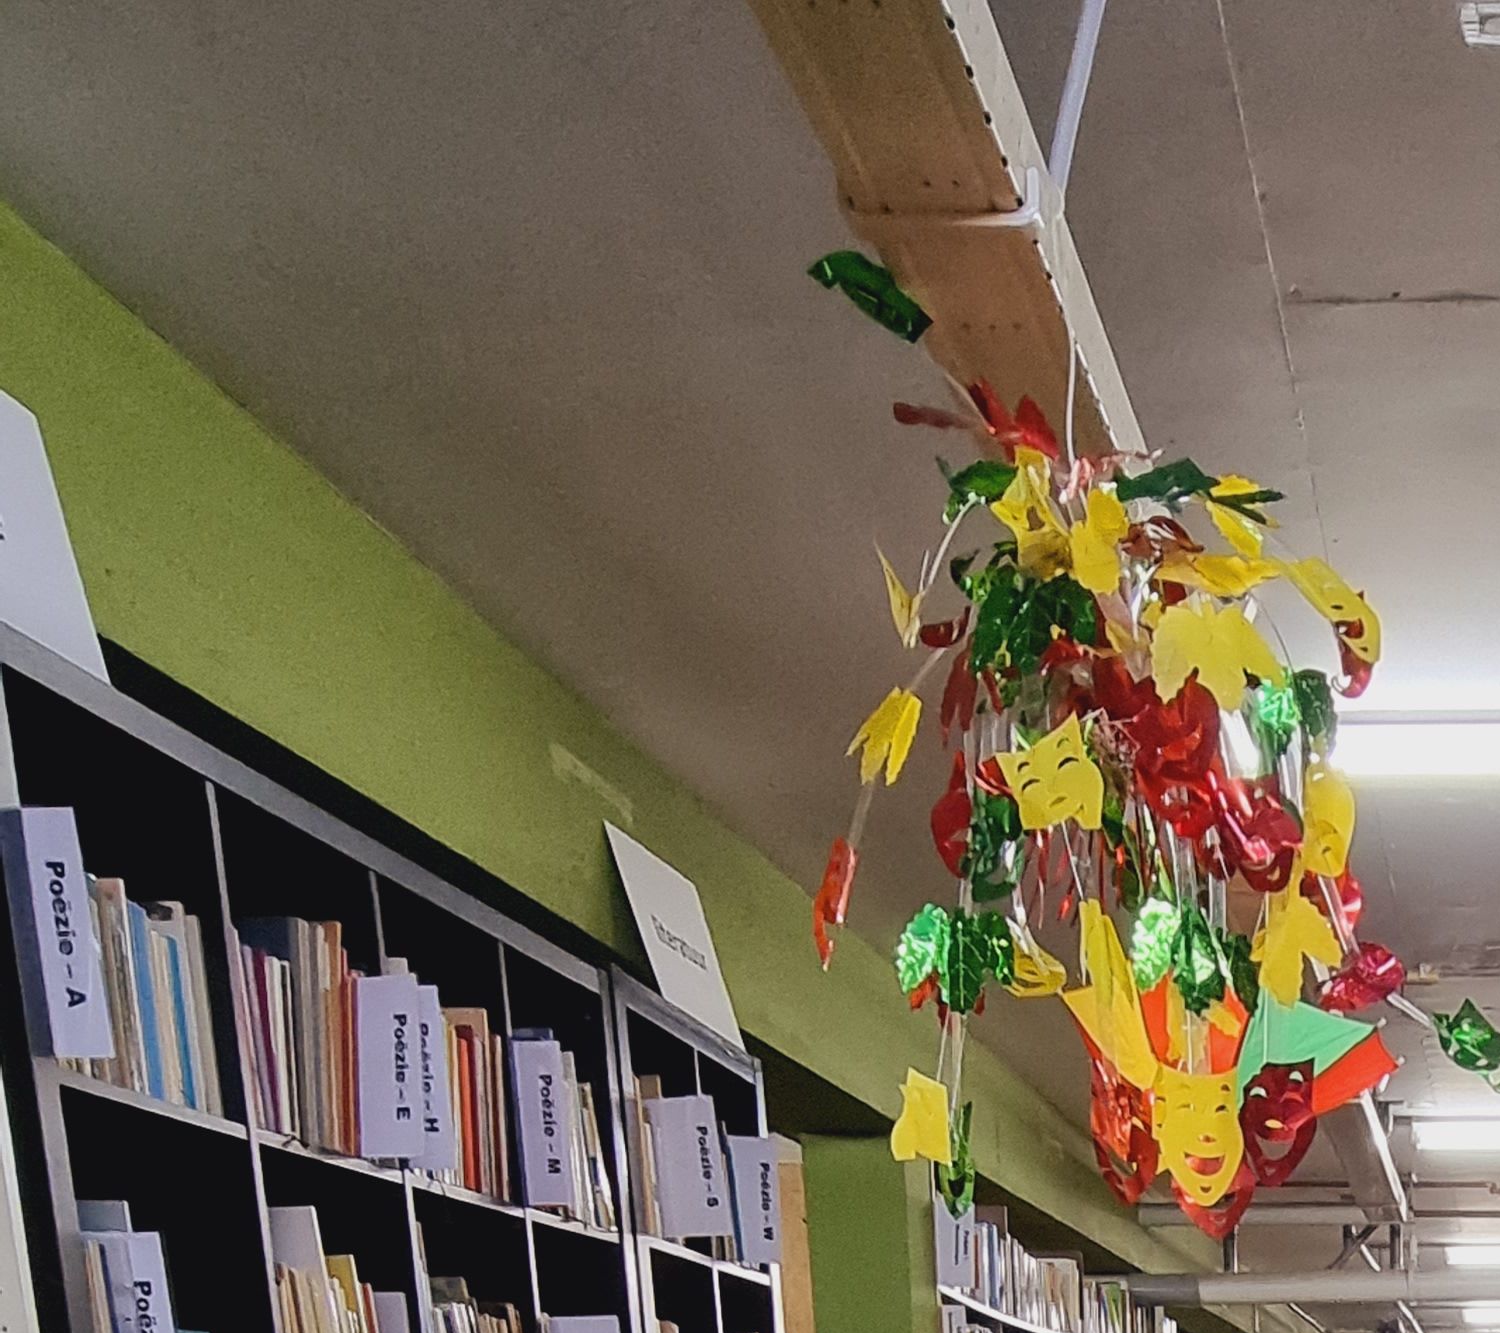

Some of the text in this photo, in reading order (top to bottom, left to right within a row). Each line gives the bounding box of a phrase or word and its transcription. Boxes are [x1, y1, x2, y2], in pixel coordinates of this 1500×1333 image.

[45, 861, 74, 955] Poëzie
[66, 987, 86, 1007] A
[393, 1014, 408, 1083] Poëzie
[397, 1107, 411, 1121] E
[424, 1118, 440, 1133] H
[539, 1074, 555, 1137] Poëzie
[548, 1158, 561, 1174] M
[696, 1125, 712, 1182] Poëzie
[760, 1162, 771, 1211] Poëzie
[763, 1226, 774, 1241] W
